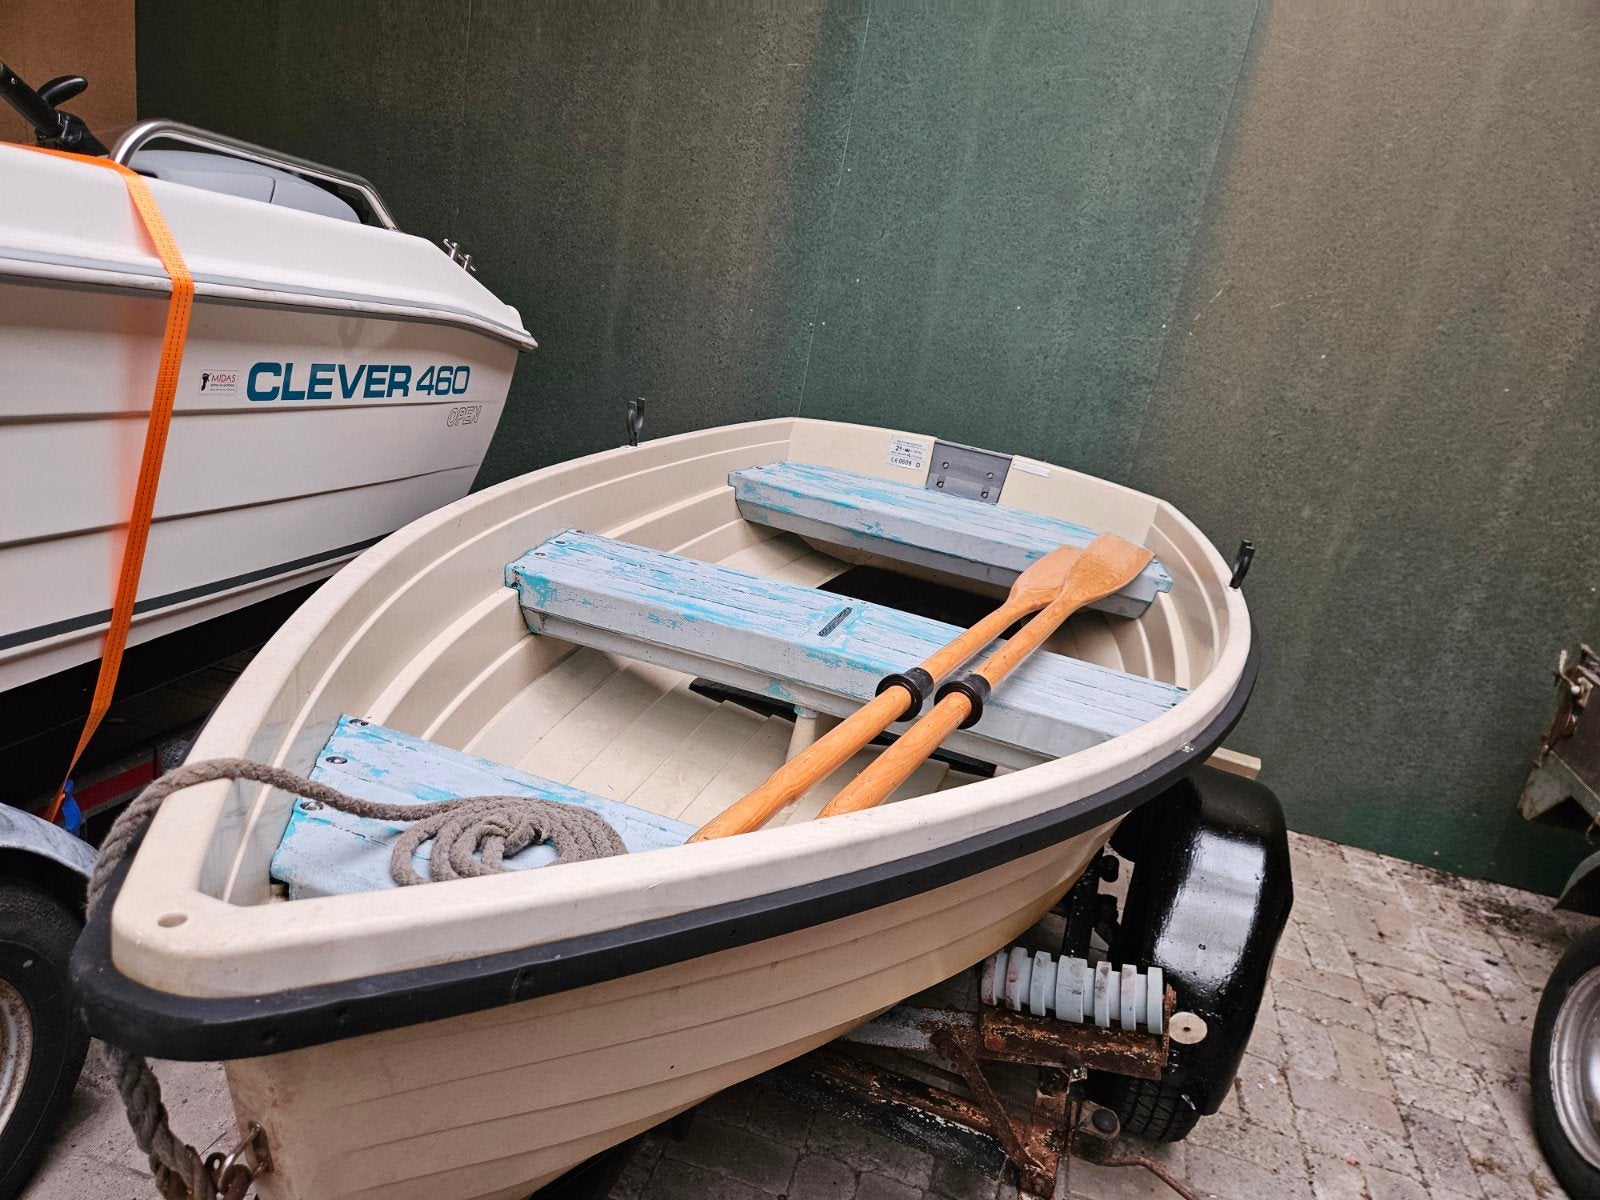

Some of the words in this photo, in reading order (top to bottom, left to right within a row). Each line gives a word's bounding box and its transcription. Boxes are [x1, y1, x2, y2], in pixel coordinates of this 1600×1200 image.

[211, 374, 236, 383] MIDAS
[247, 362, 412, 401] CLEVER
[416, 366, 470, 395] 460
[447, 406, 482, 427] OPEN
